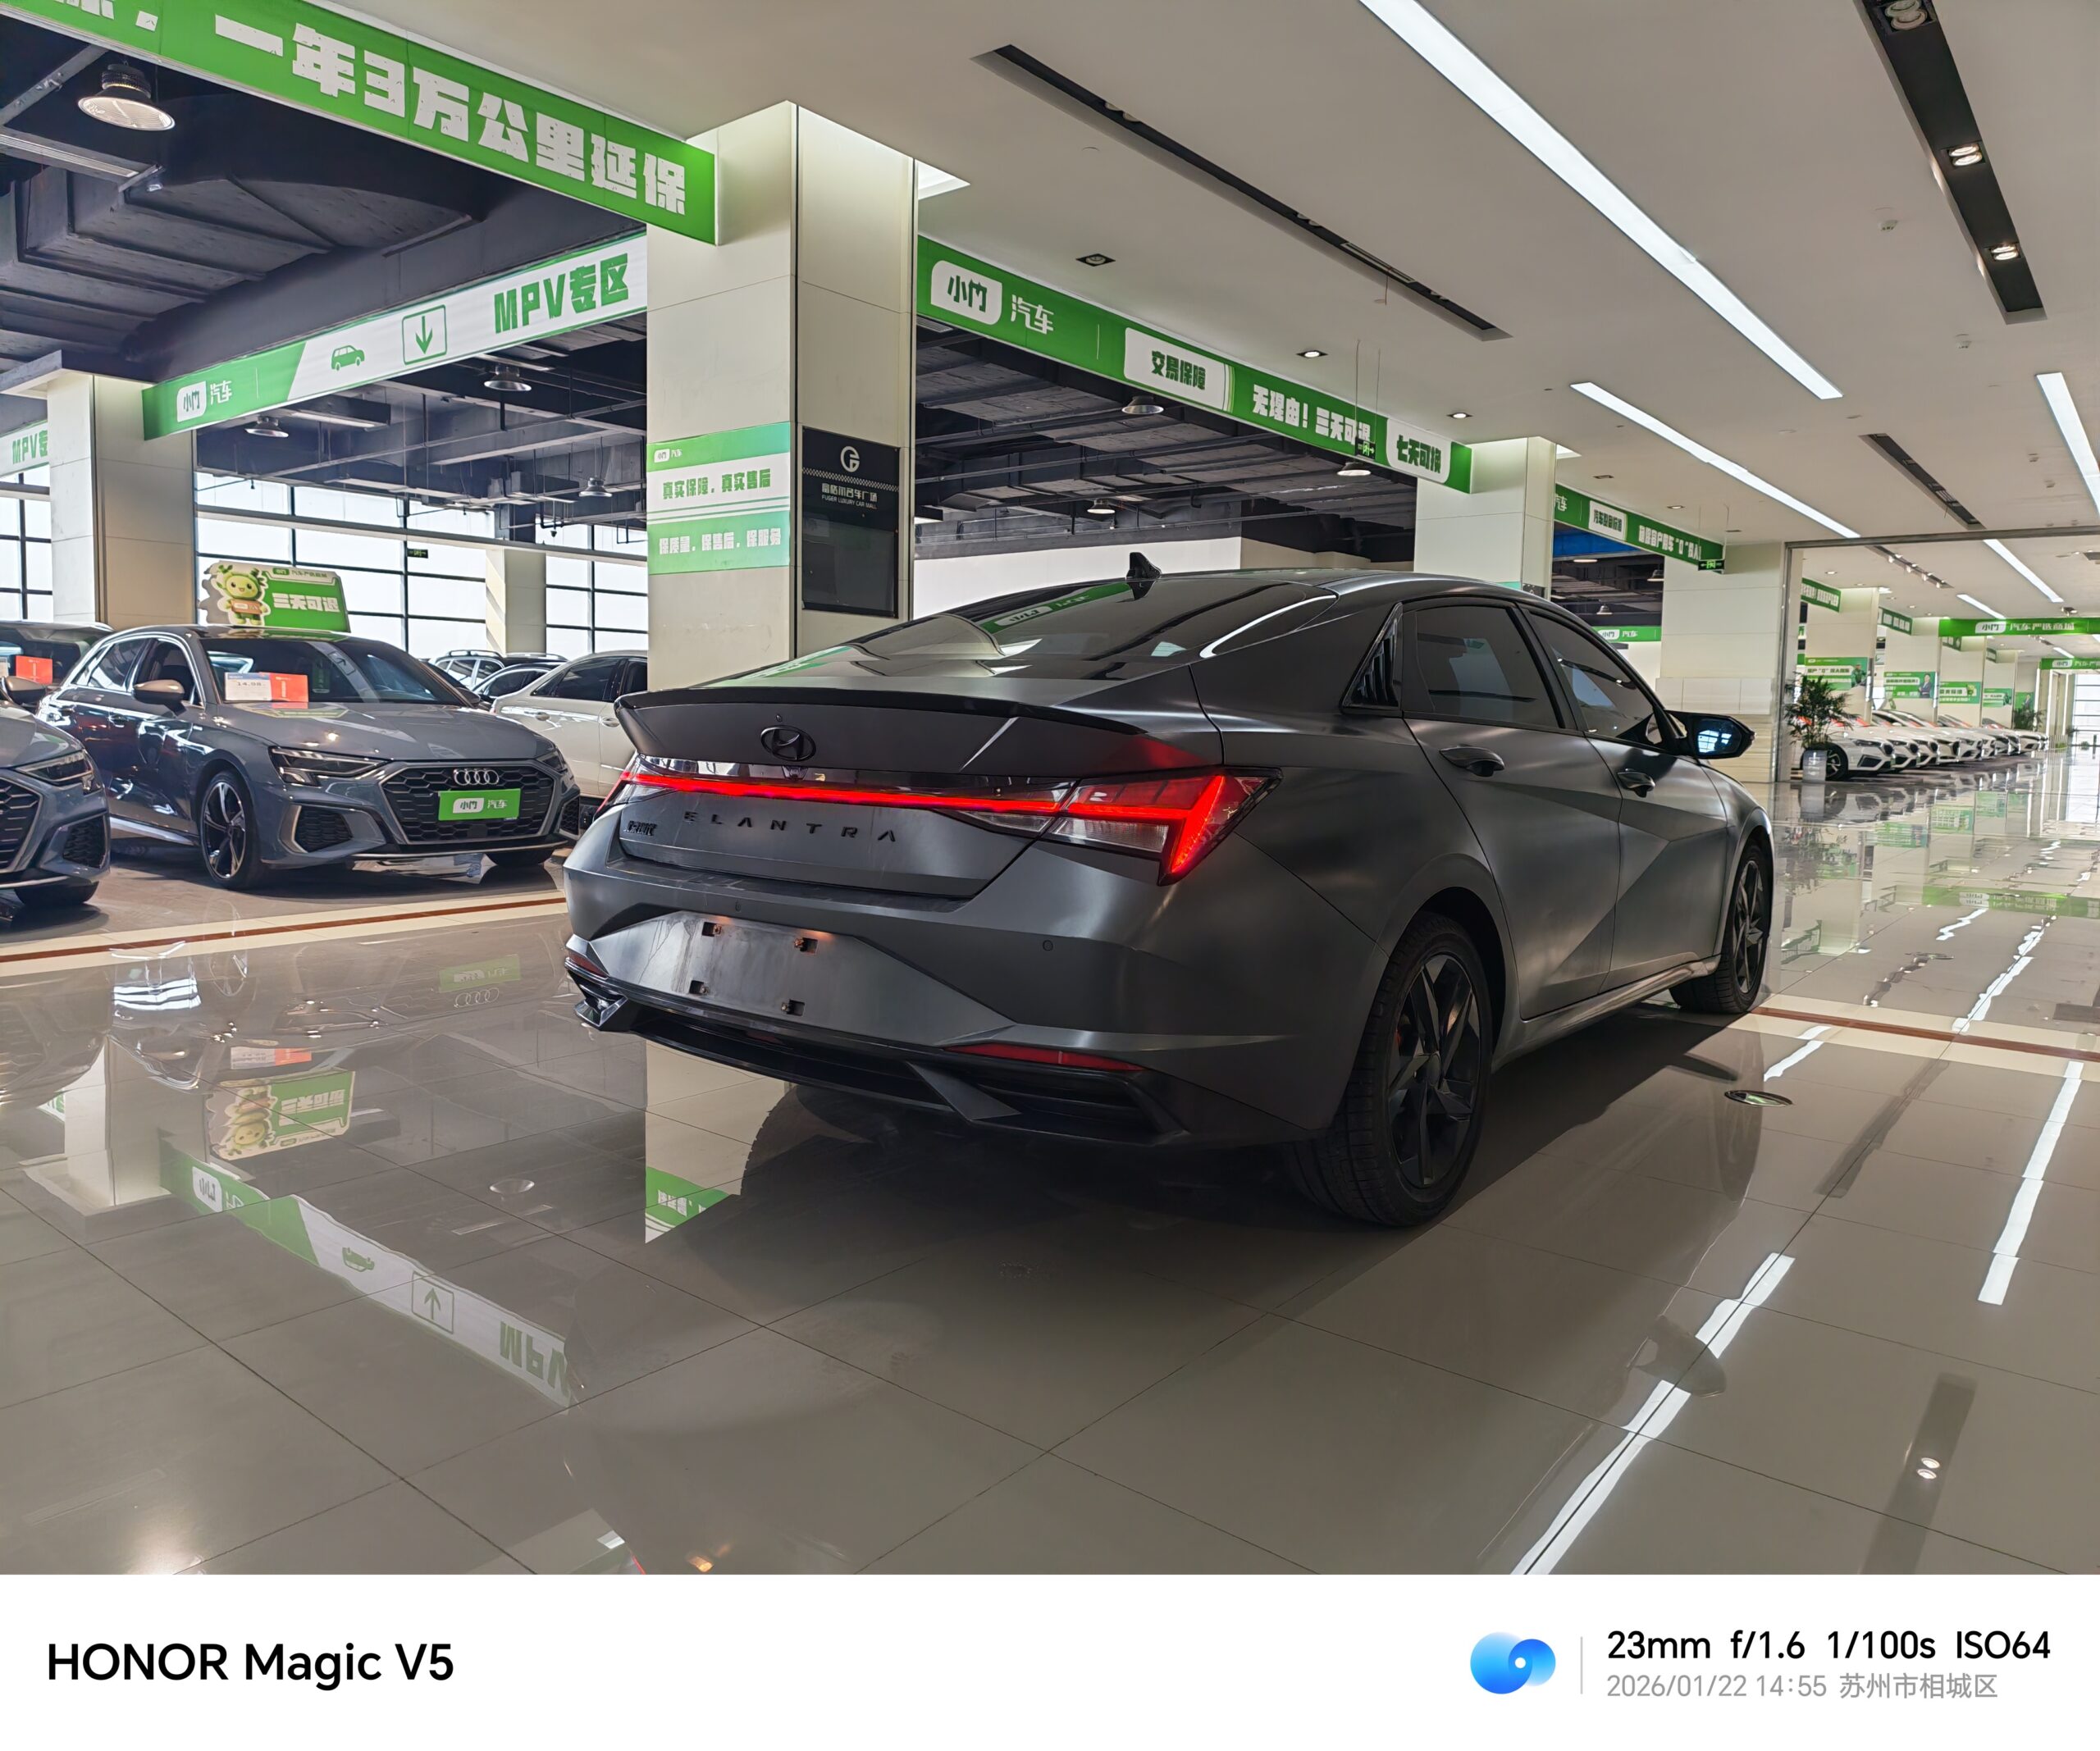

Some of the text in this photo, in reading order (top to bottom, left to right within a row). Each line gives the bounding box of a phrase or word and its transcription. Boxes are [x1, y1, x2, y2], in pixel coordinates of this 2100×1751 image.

[494, 253, 629, 334] MPV专区
[1011, 293, 1054, 335] 汽车
[1152, 350, 1207, 390] 交易保障
[210, 381, 232, 405] 汽车
[1397, 434, 1441, 474] 七天可换
[272, 593, 340, 612] 三天可退
[684, 811, 896, 842] ELANTRA
